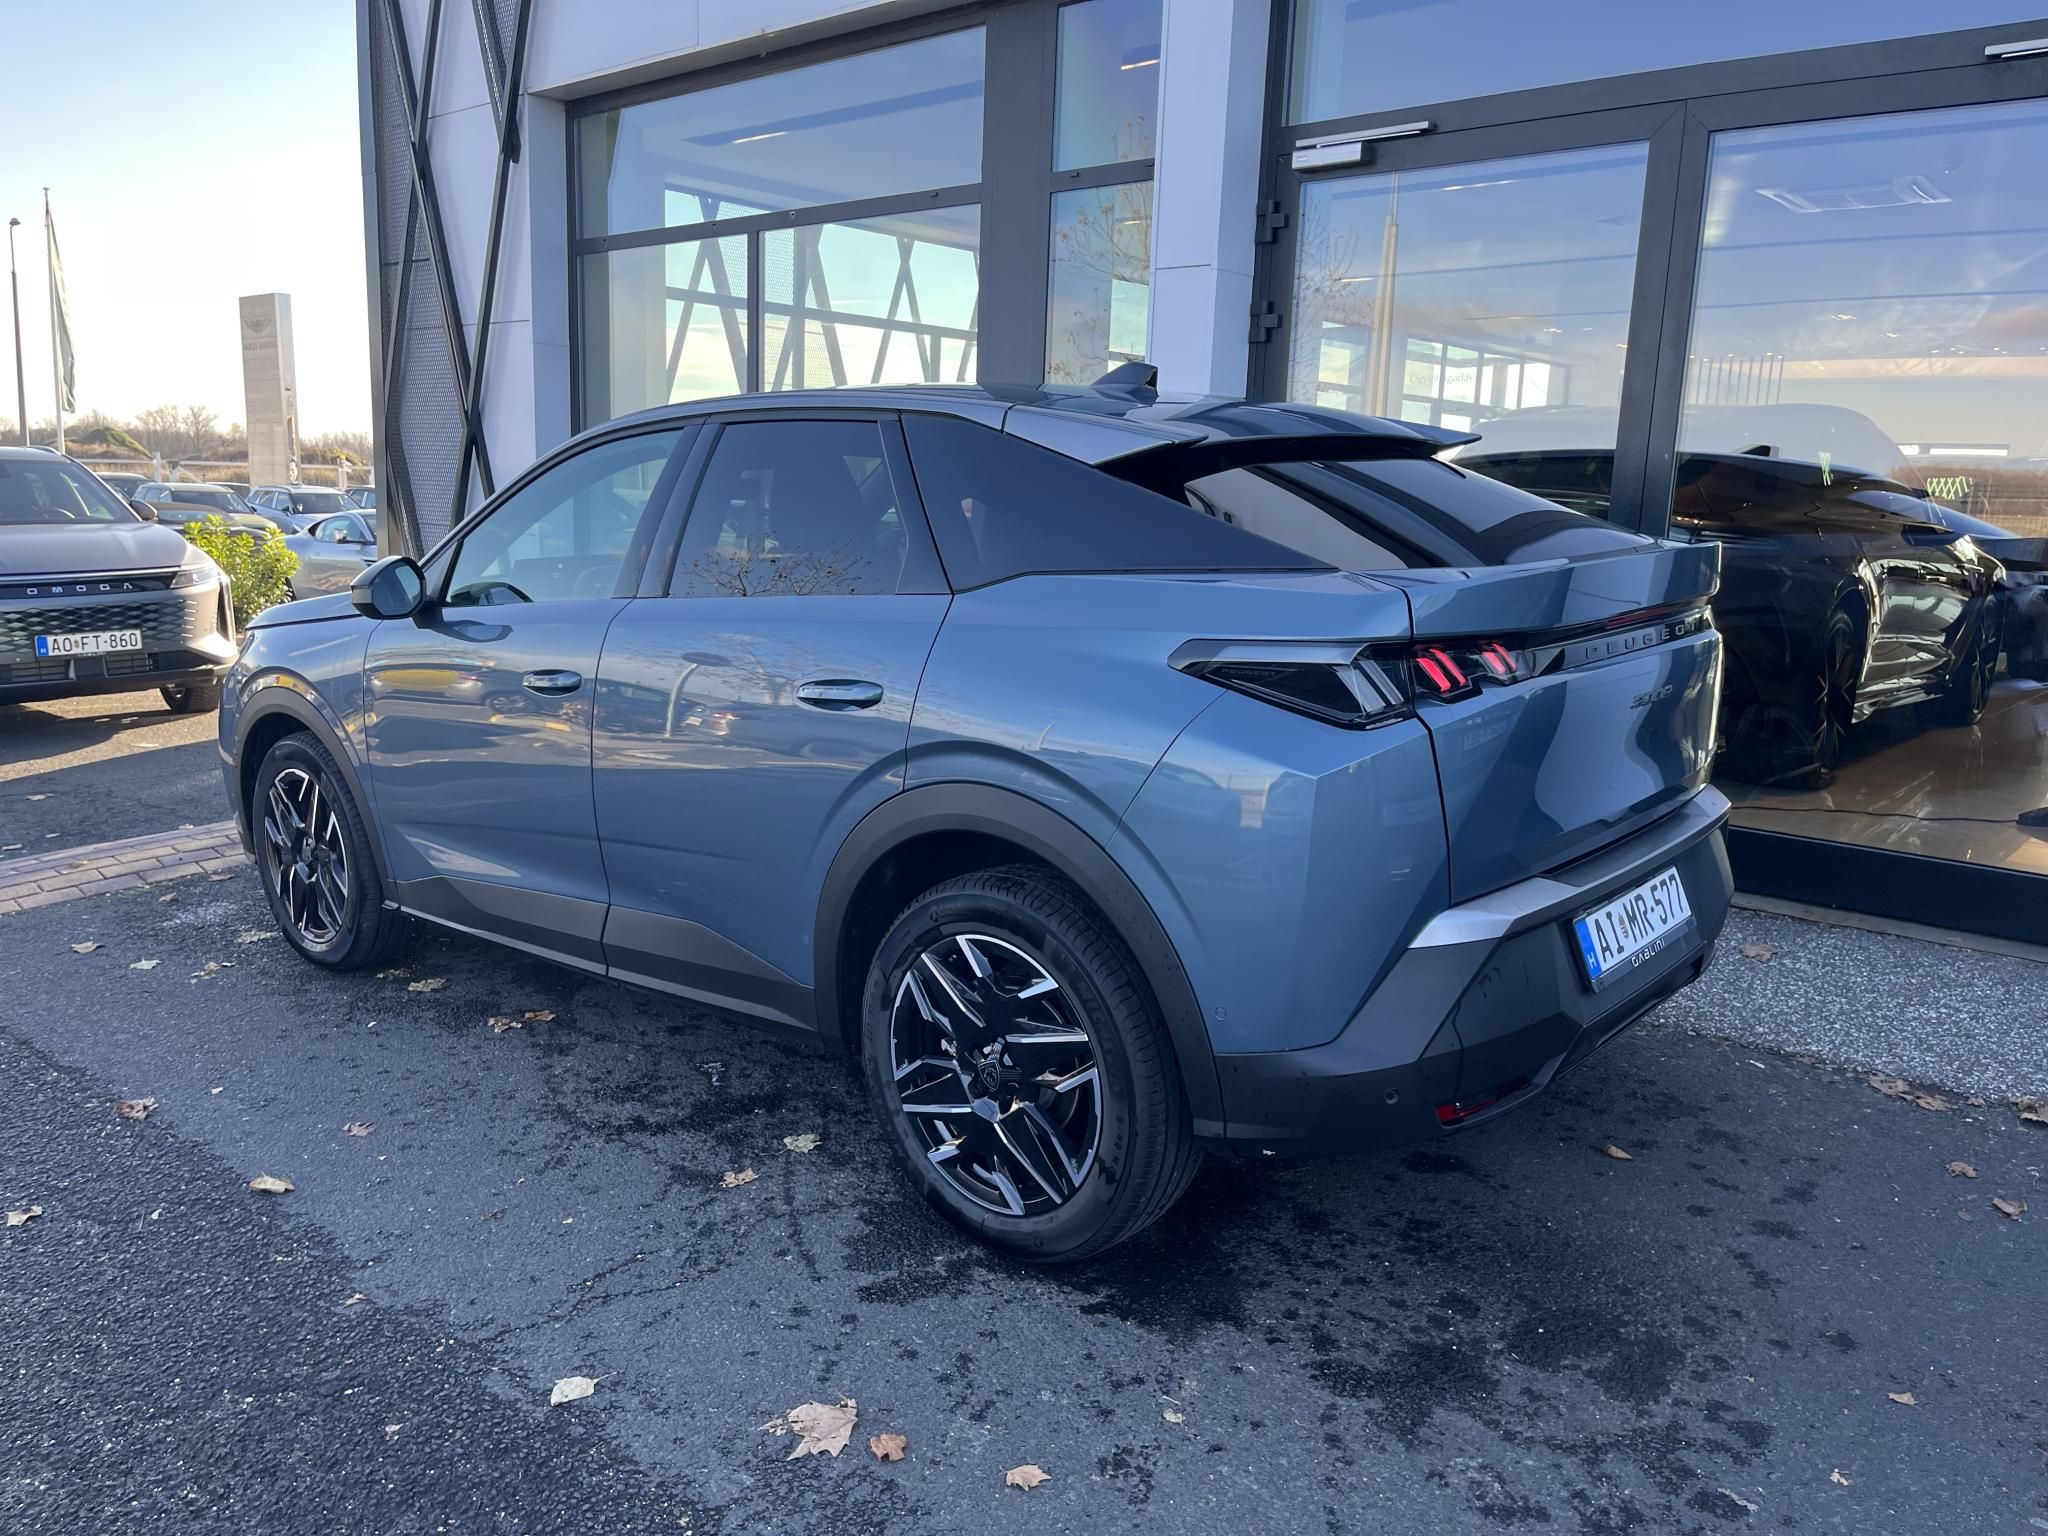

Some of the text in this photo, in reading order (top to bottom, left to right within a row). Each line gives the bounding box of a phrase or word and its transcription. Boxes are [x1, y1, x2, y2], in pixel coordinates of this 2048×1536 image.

[27, 582, 133, 595] OMODA
[52, 632, 138, 653] AO FT-860
[1585, 621, 1697, 659] PEUGEOT
[1594, 872, 1684, 963] AI MR-577
[1587, 951, 1597, 969] H
[1631, 938, 1665, 967] GABLINI
